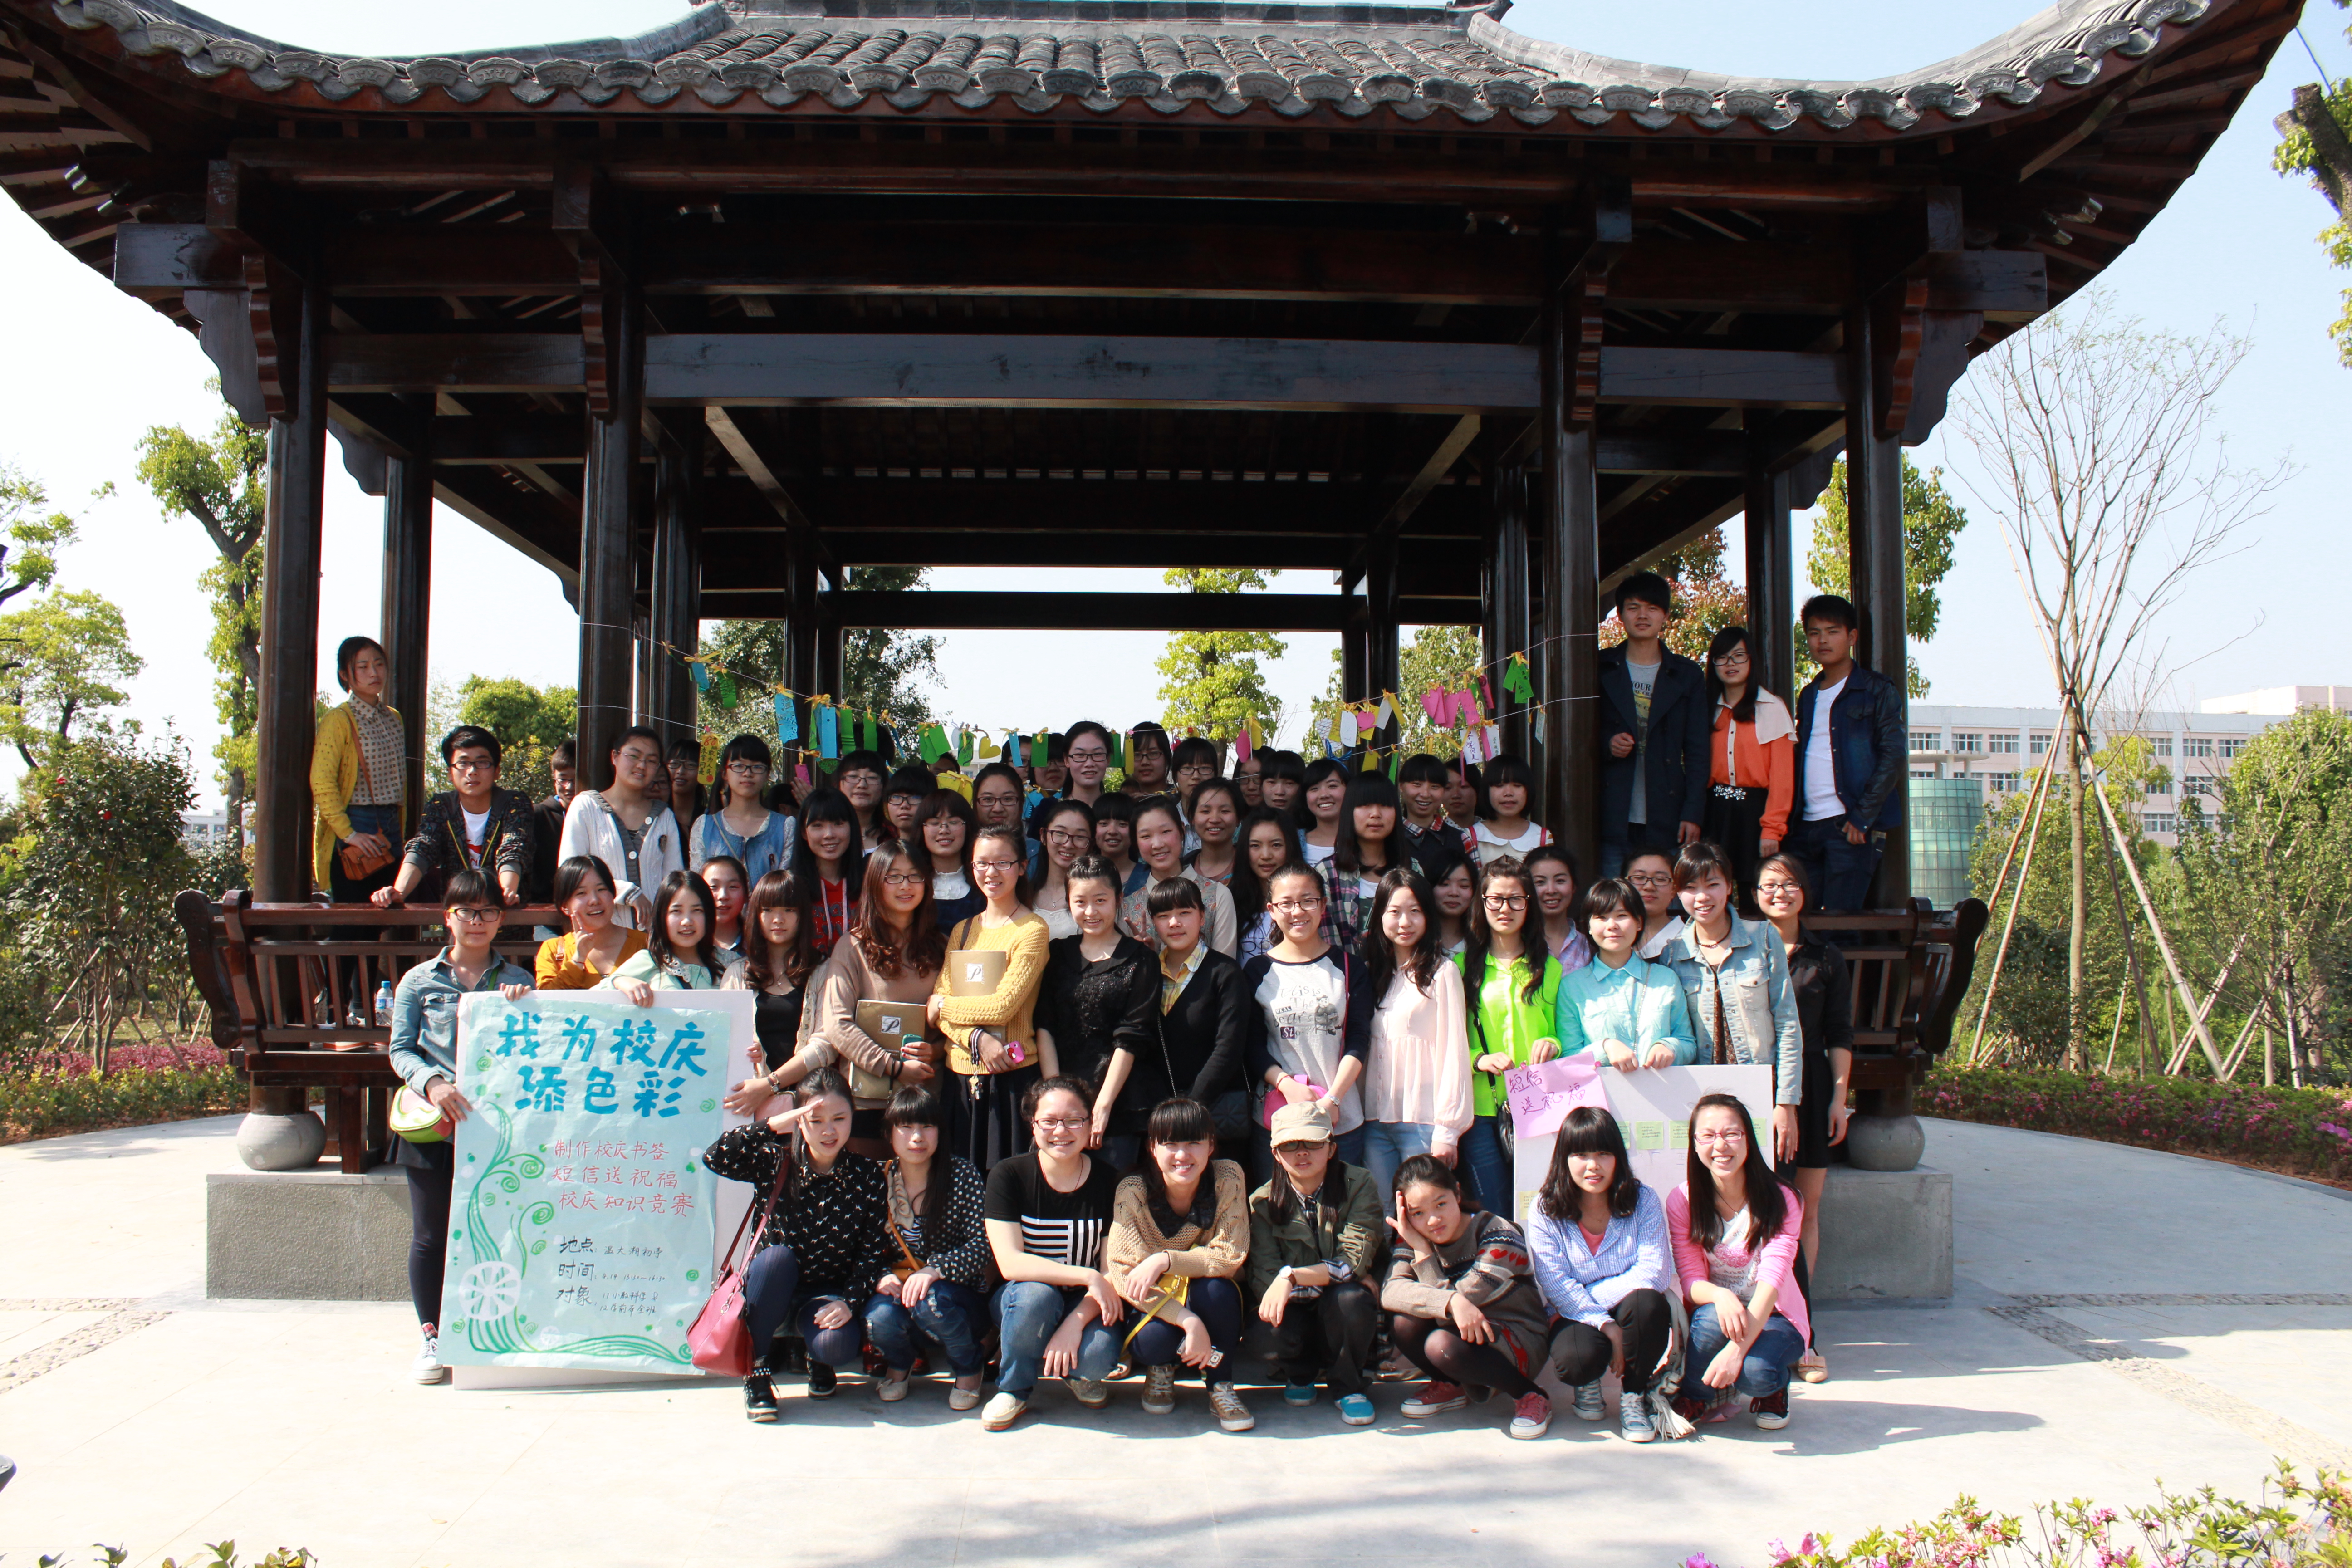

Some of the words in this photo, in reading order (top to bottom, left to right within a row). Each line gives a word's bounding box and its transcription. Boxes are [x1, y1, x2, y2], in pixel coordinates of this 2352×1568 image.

[1276, 1006, 1292, 1014] REAL
[1290, 997, 1314, 1010] The
[496, 1012, 708, 1077] 我为校庆
[515, 1065, 686, 1118] 添色彩
[1509, 1070, 1543, 1094] 短信
[1521, 1082, 1586, 1116] 送祝福
[554, 1139, 669, 1161] 制作校庆书签
[551, 1165, 678, 1189] 短信送祝福
[558, 1189, 695, 1218] 校庆知识竞赛
